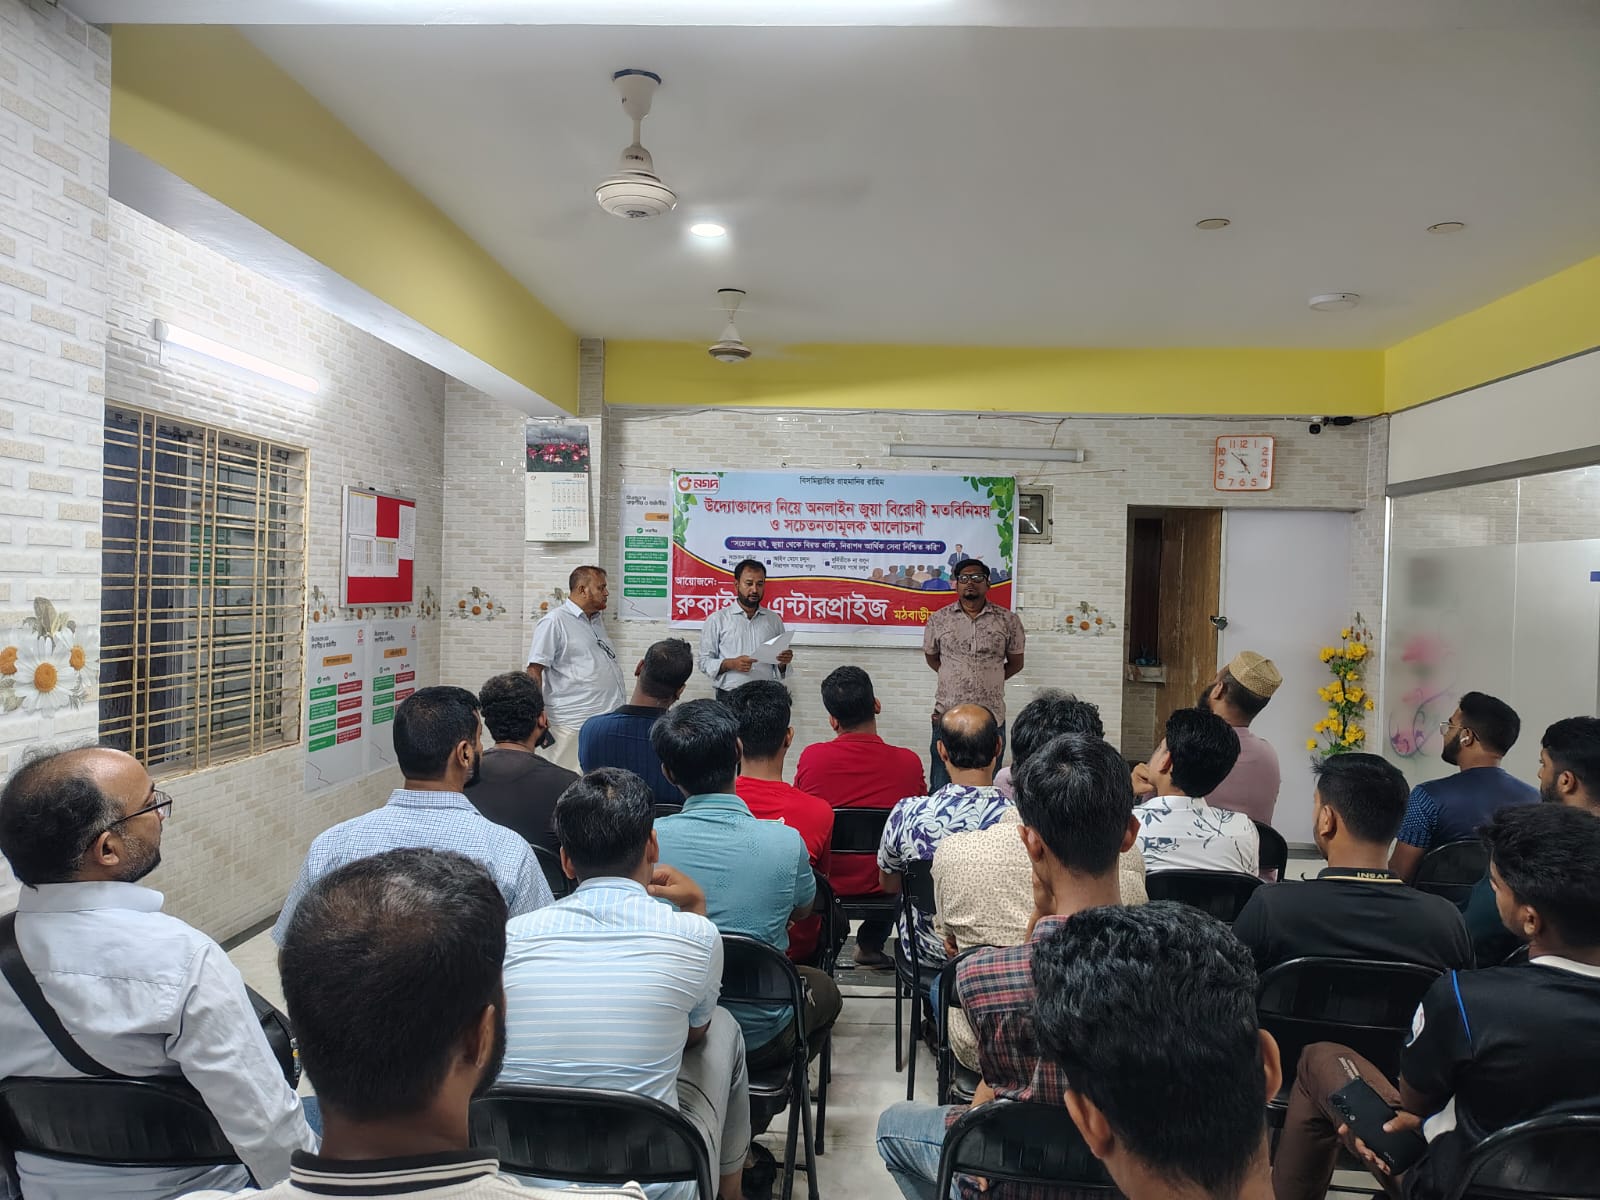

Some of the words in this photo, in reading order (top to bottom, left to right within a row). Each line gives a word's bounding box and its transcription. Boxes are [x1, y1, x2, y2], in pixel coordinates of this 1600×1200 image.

[1229, 440, 1236, 448] 11
[1240, 440, 1248, 448] 12
[1218, 447, 1226, 456] 10
[1262, 447, 1268, 455] 2
[1219, 459, 1225, 467] 9
[1262, 459, 1268, 467] 3
[1218, 471, 1224, 479] 8
[1261, 471, 1267, 479] 4
[693, 479, 719, 489] নগদ
[1228, 478, 1234, 486] 7
[1239, 478, 1246, 486] 6
[1251, 478, 1257, 486] 5
[704, 498, 772, 514] উদ্যোক্তাদের
[776, 498, 801, 514] নিয়ে
[806, 500, 855, 516] অনলাইন
[859, 502, 881, 519] জুয়া
[885, 500, 928, 518] বিরোধী
[931, 501, 992, 519] মতবিনিময়
[770, 519, 780, 531] ও
[784, 519, 867, 537] সচেতনতামূলক
[870, 521, 925, 536] আলোচনা
[786, 541, 802, 549] থেকে
[864, 541, 884, 550] আর্থিক
[887, 543, 901, 551] সেবা
[768, 590, 890, 622] এন্টারপ্রাইজ
[893, 606, 935, 624] মঠবাড়ী
